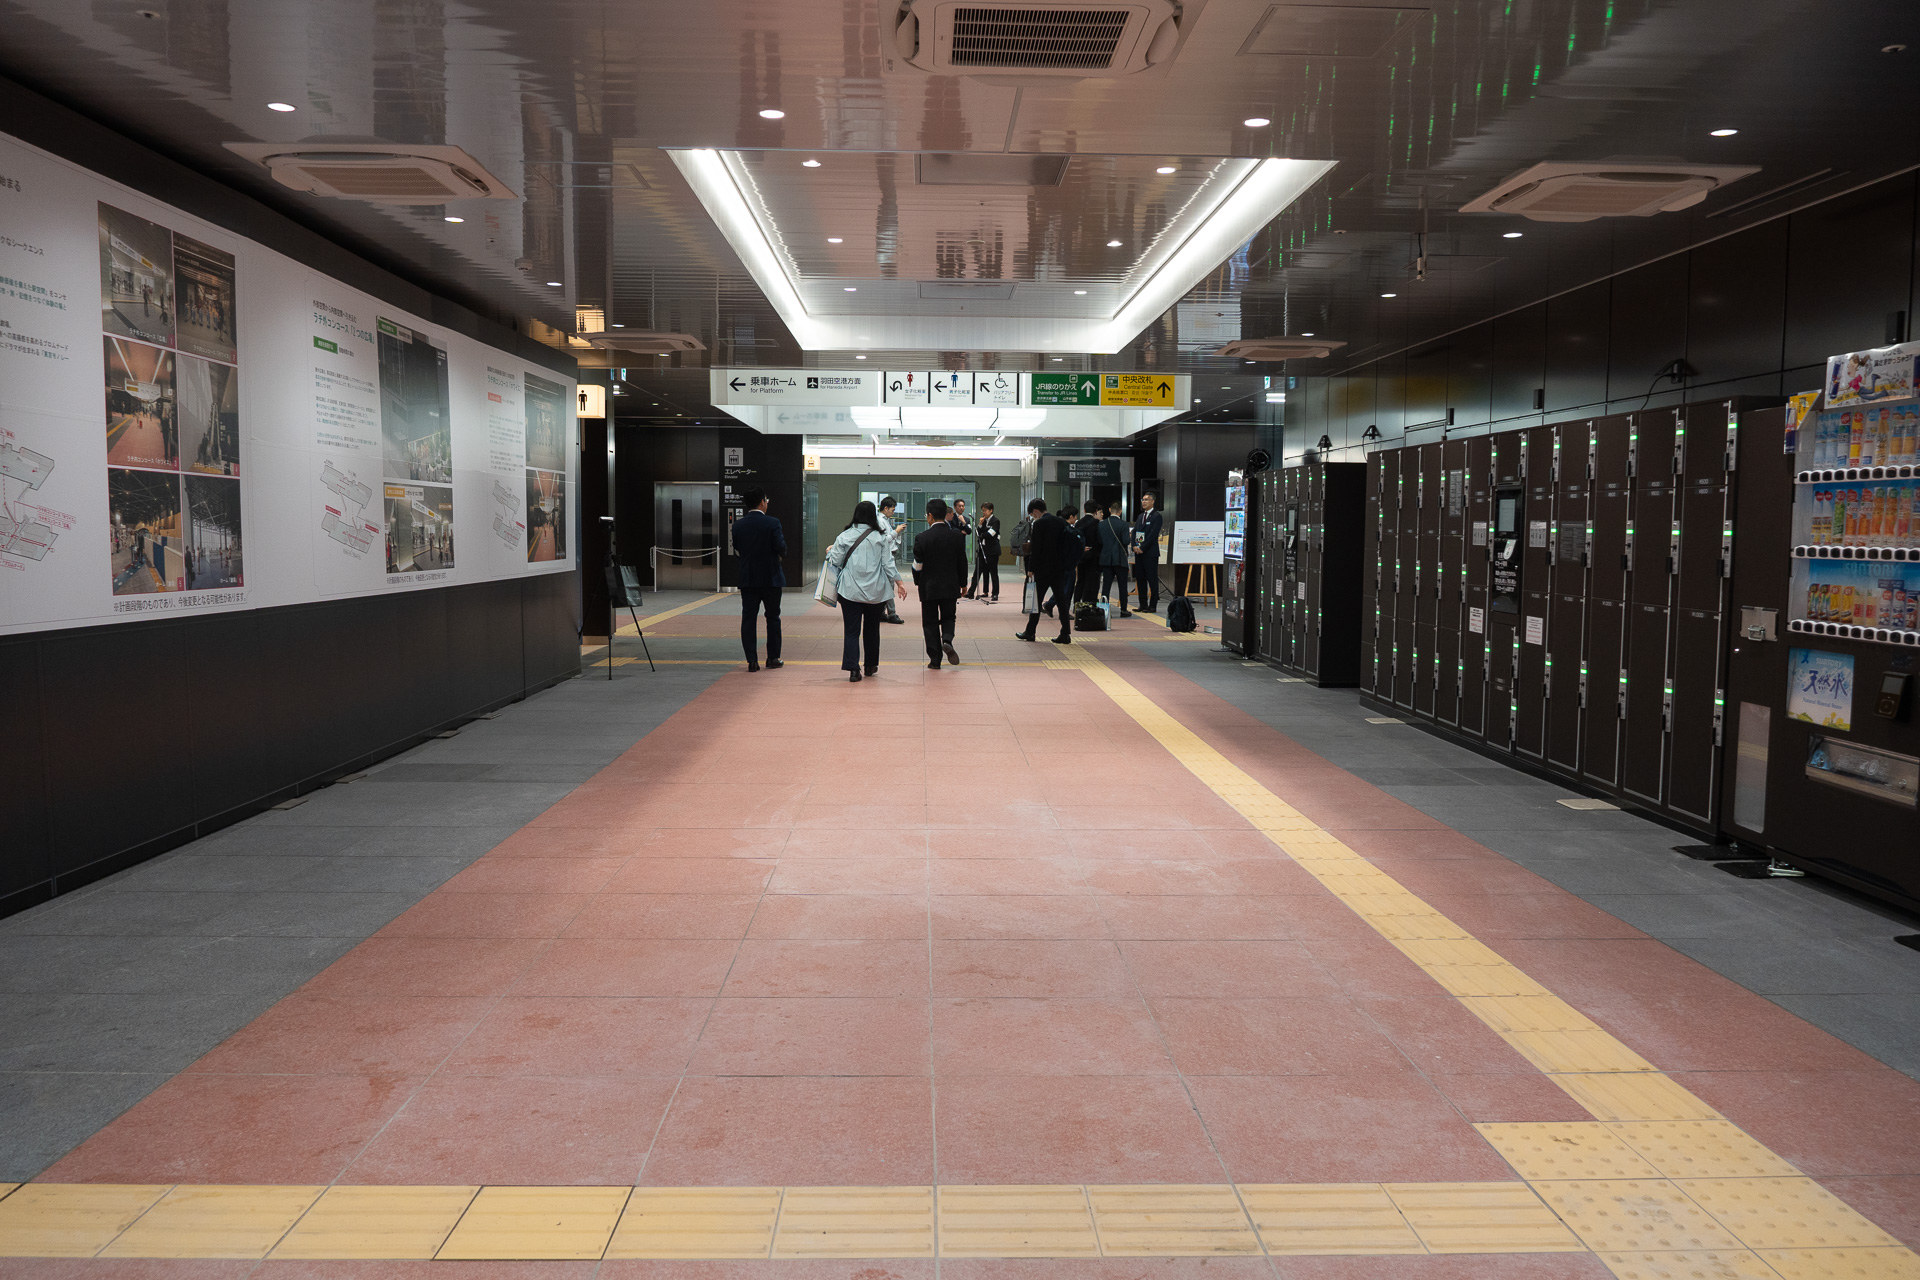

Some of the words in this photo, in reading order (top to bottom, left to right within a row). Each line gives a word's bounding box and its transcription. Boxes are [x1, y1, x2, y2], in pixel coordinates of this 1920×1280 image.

[750, 376, 797, 387] 乗車ホーム
[820, 377, 862, 385] 羽田空港方面
[1122, 375, 1154, 384] 中央改札
[1035, 383, 1078, 391] JR線のりかえ
[1845, 562, 1901, 577] SUNTORY
[1815, 657, 1843, 668] SUNTORY
[1802, 669, 1848, 699] 天然水
[1817, 700, 1831, 708] Mineral
[1831, 702, 1843, 710] Water
